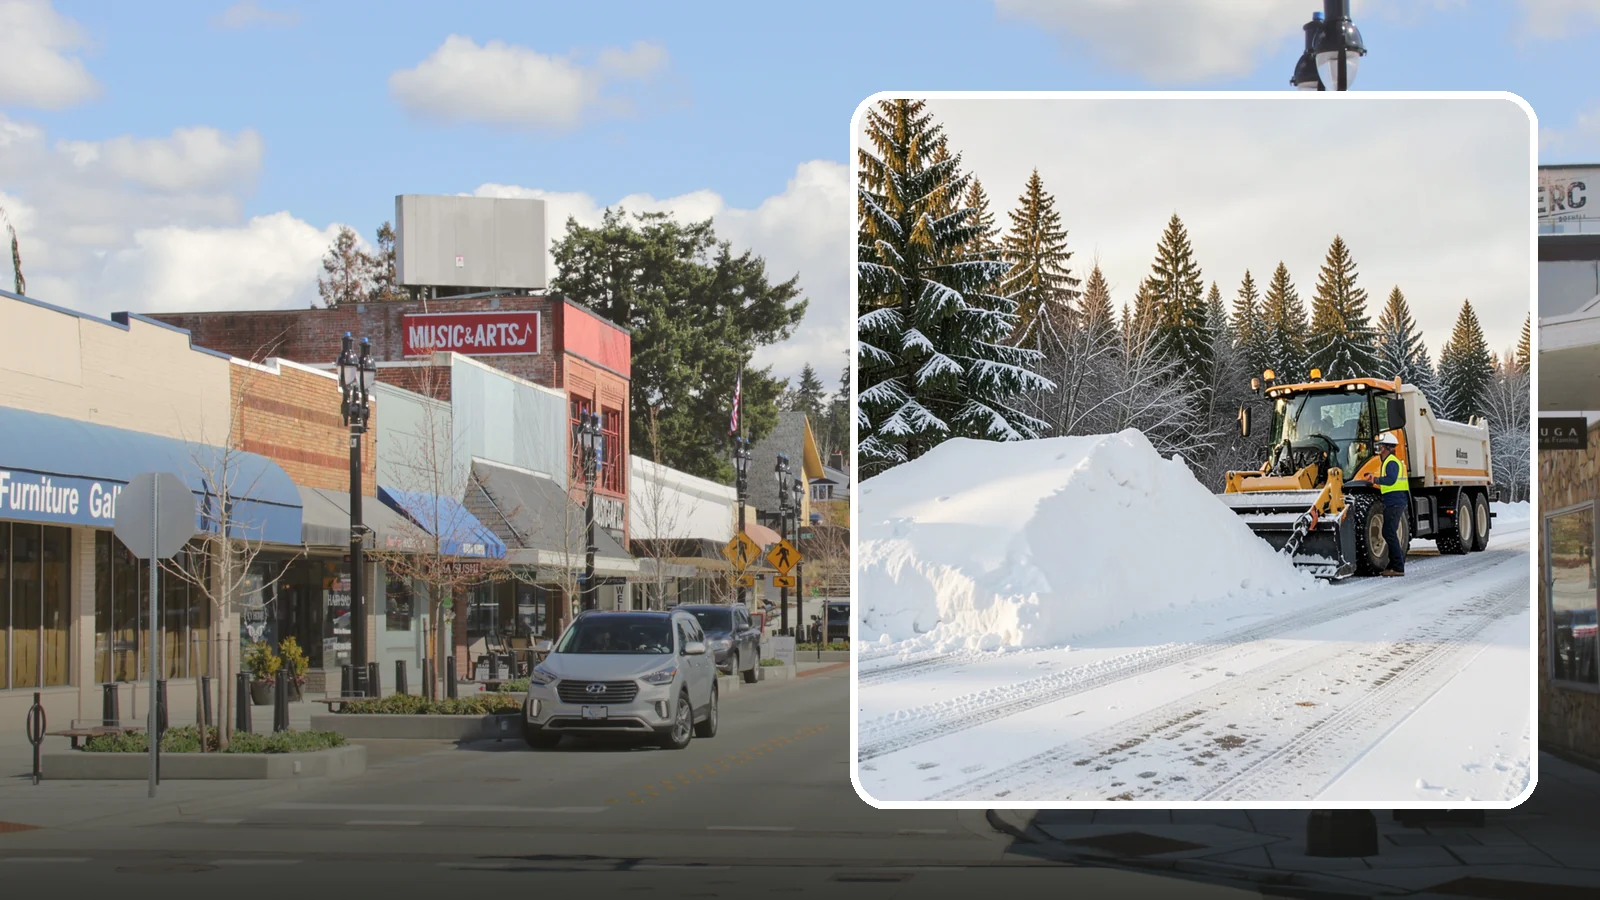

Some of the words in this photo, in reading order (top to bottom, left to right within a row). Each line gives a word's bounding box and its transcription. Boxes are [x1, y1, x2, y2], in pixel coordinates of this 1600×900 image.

[409, 323, 519, 348] MUSIC&ARTS
[1540, 427, 1577, 437] UGA
[0, 472, 79, 515] Furniture
